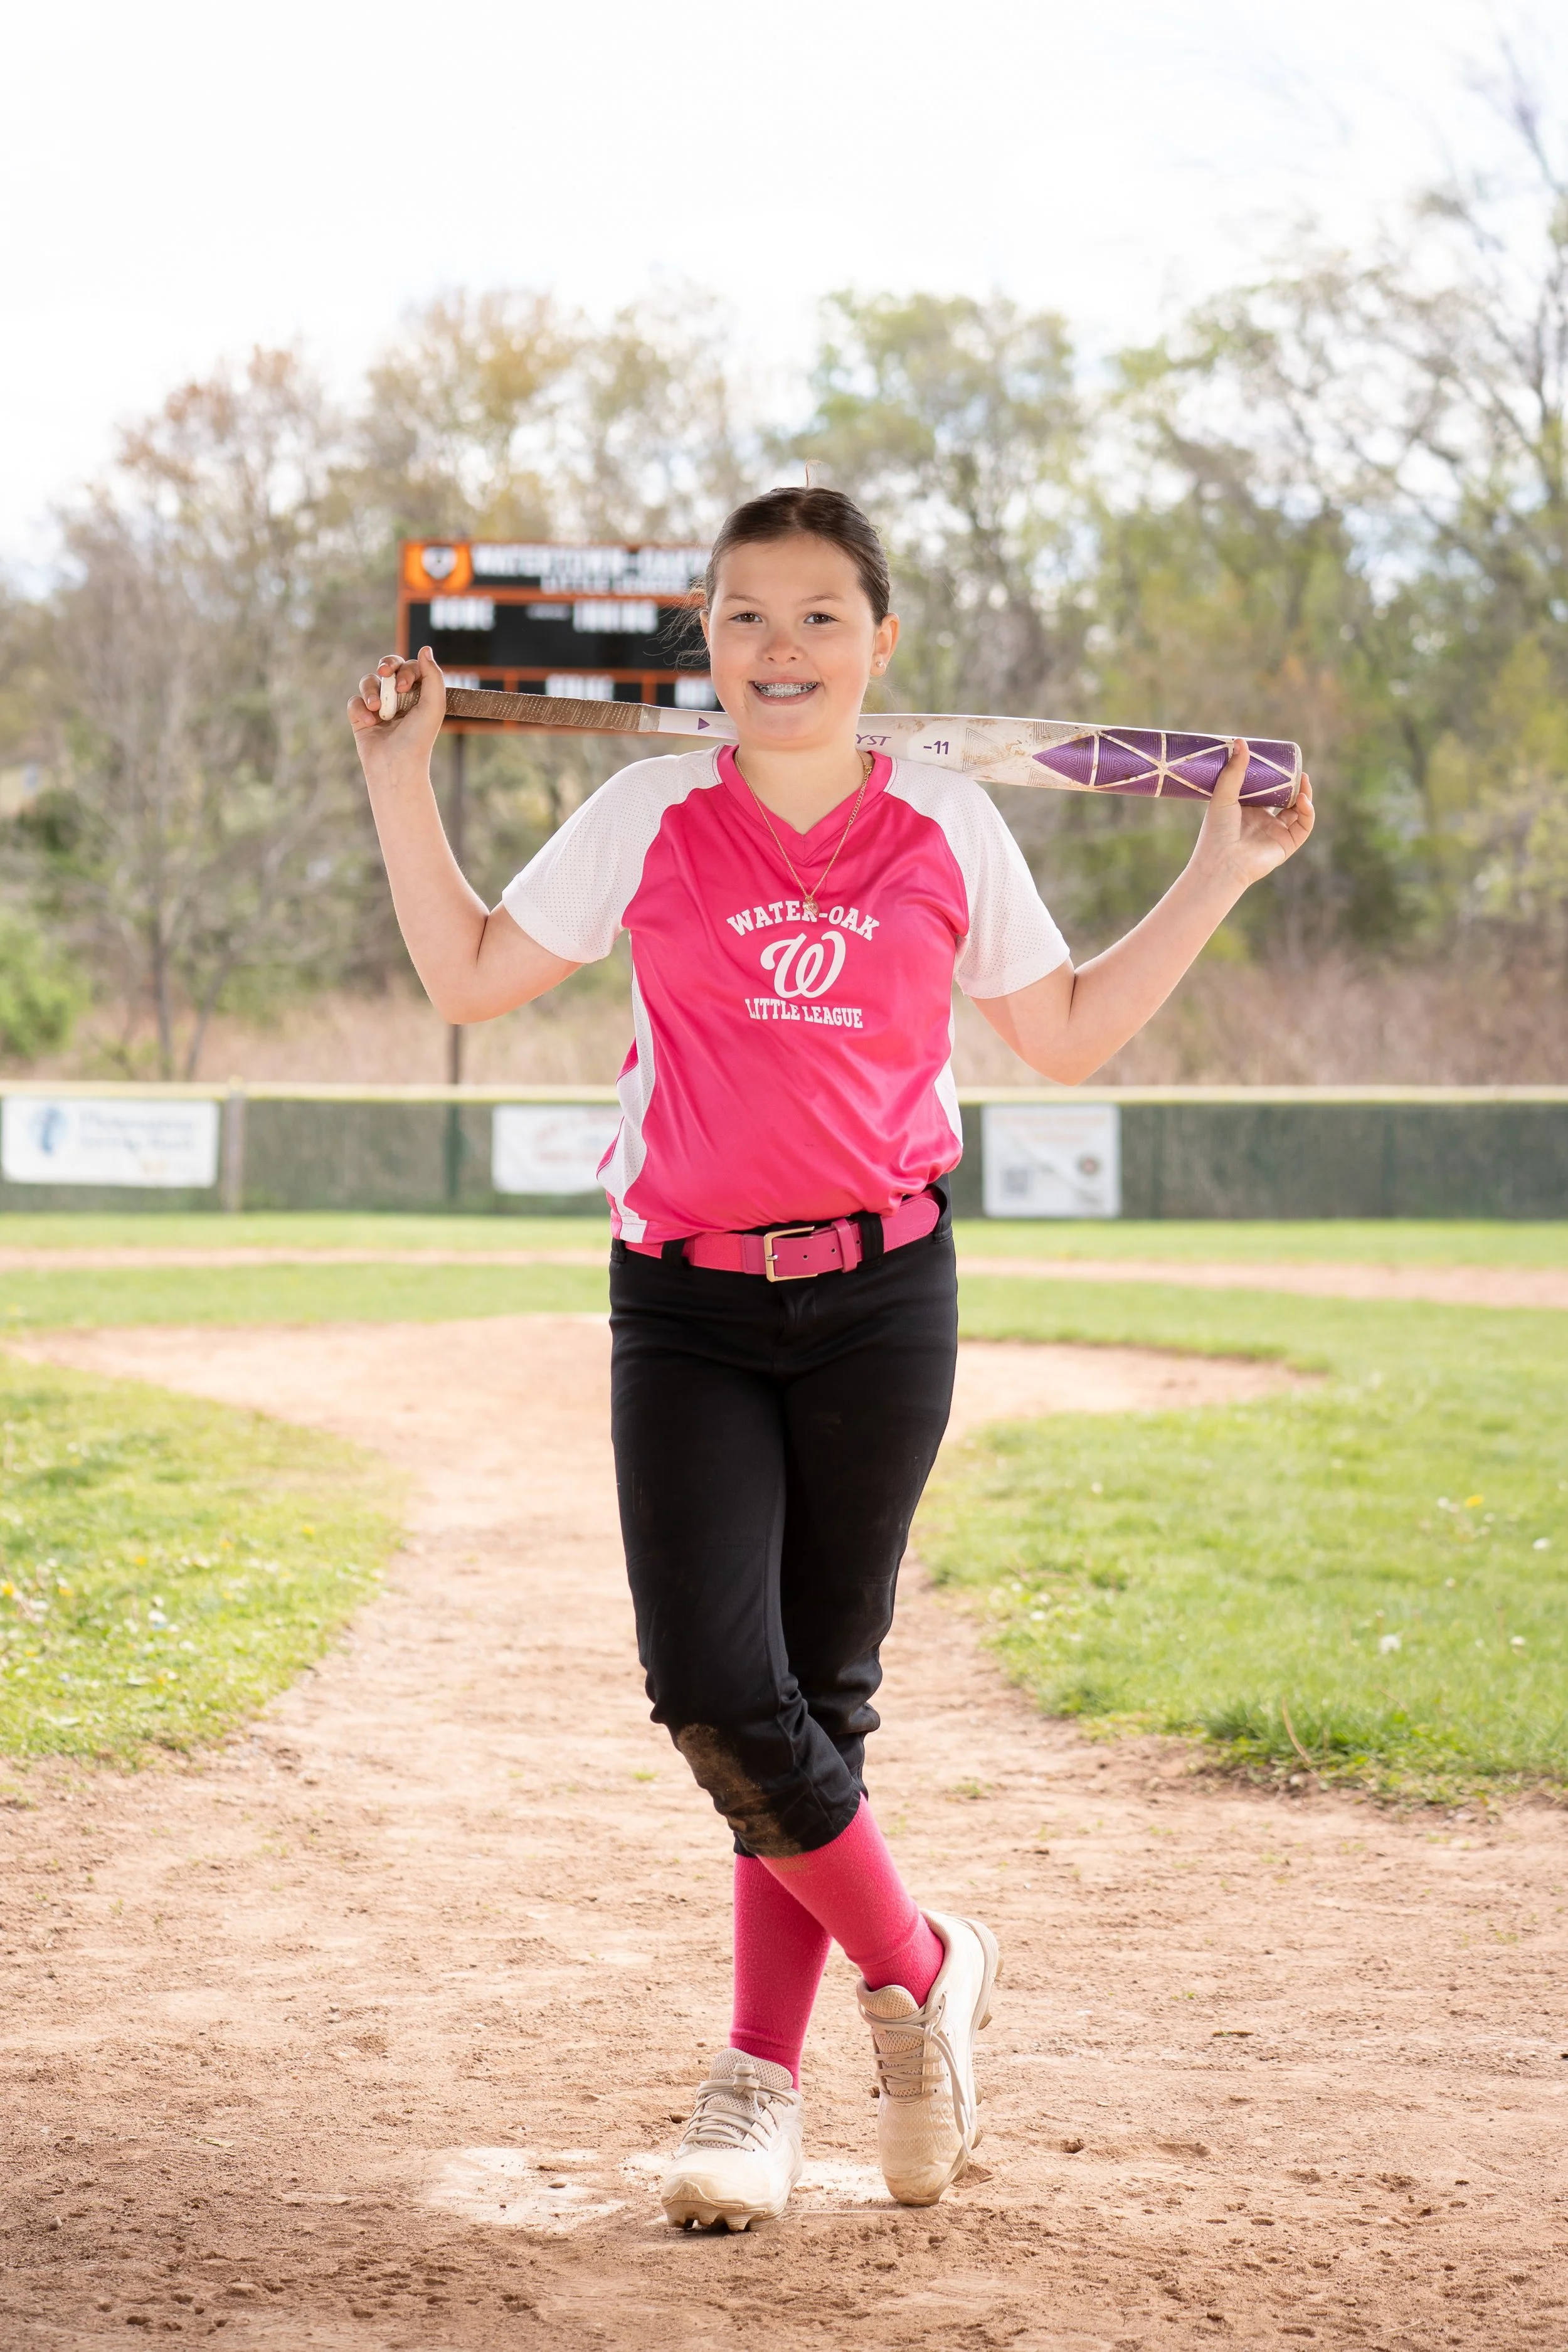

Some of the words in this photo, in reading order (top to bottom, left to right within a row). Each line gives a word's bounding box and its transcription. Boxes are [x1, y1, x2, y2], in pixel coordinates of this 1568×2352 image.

[923, 740, 949, 755] -11
[726, 901, 879, 941] WATER-OAK
[760, 931, 845, 998] W
[744, 998, 800, 1020] LITTLE
[802, 1006, 863, 1029] LEAGUE
